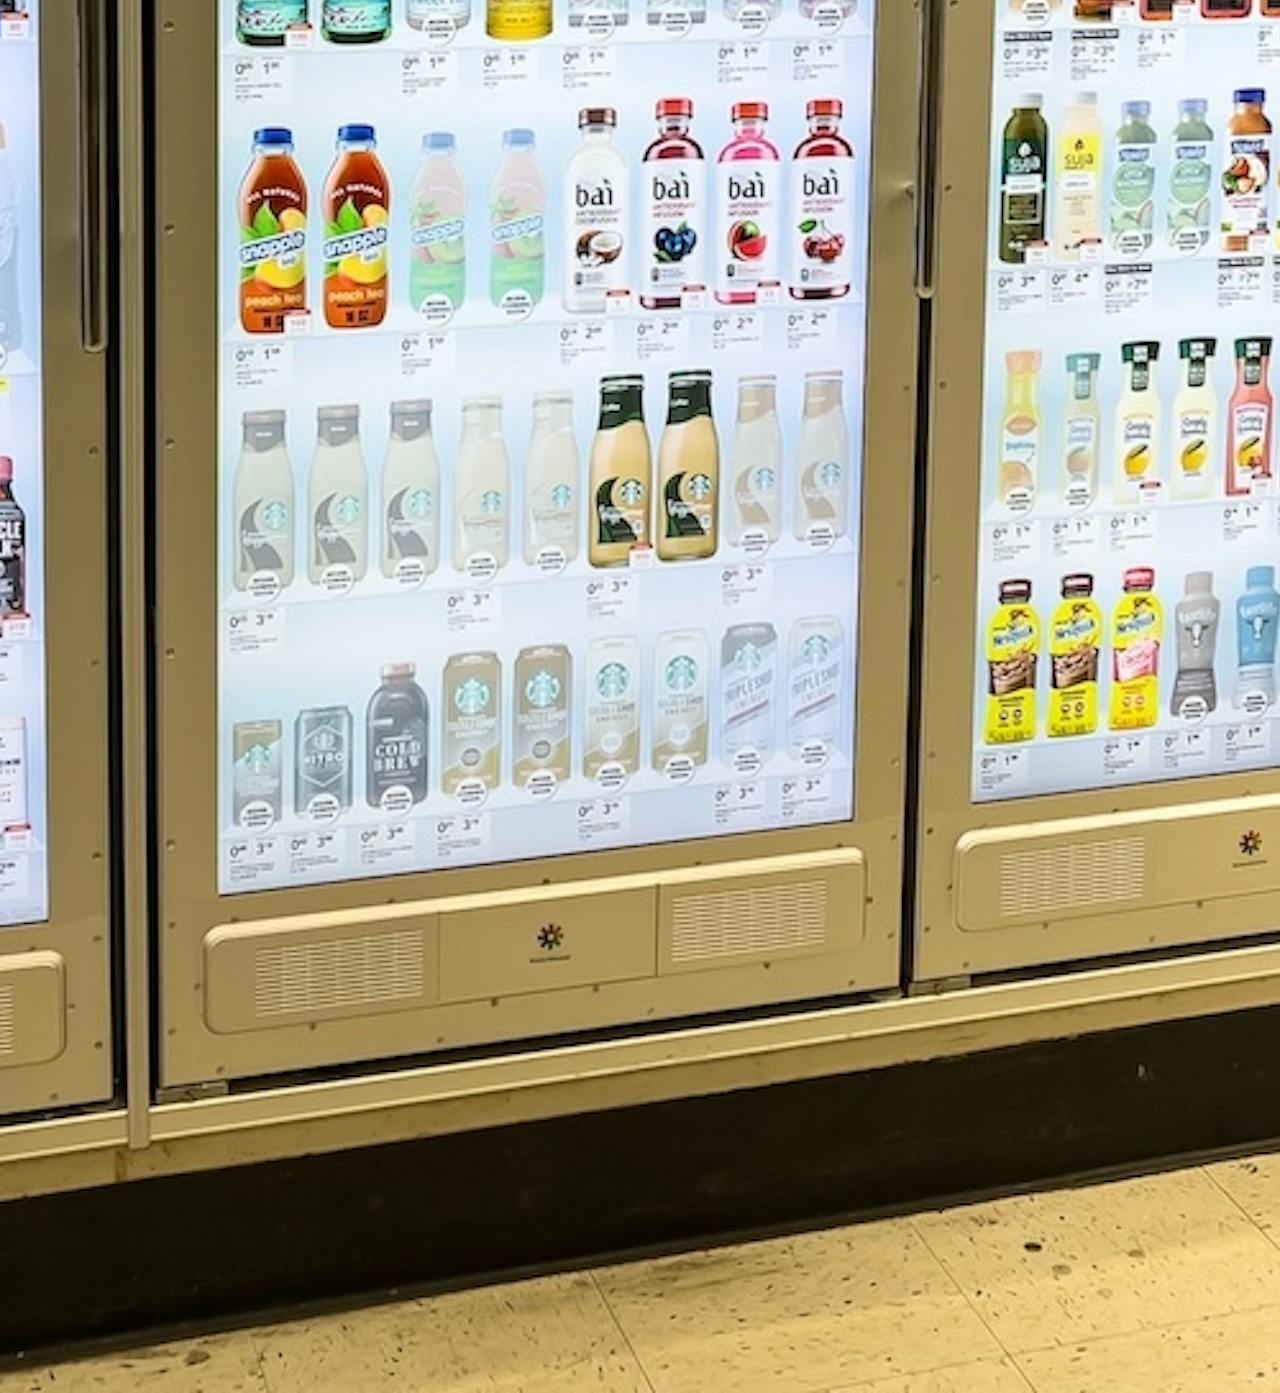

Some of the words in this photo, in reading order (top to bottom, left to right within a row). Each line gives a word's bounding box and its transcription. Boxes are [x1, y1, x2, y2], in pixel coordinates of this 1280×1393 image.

[576, 178, 613, 207] bai
[653, 171, 690, 200] bai
[728, 171, 766, 199] bai
[803, 169, 839, 195] bai
